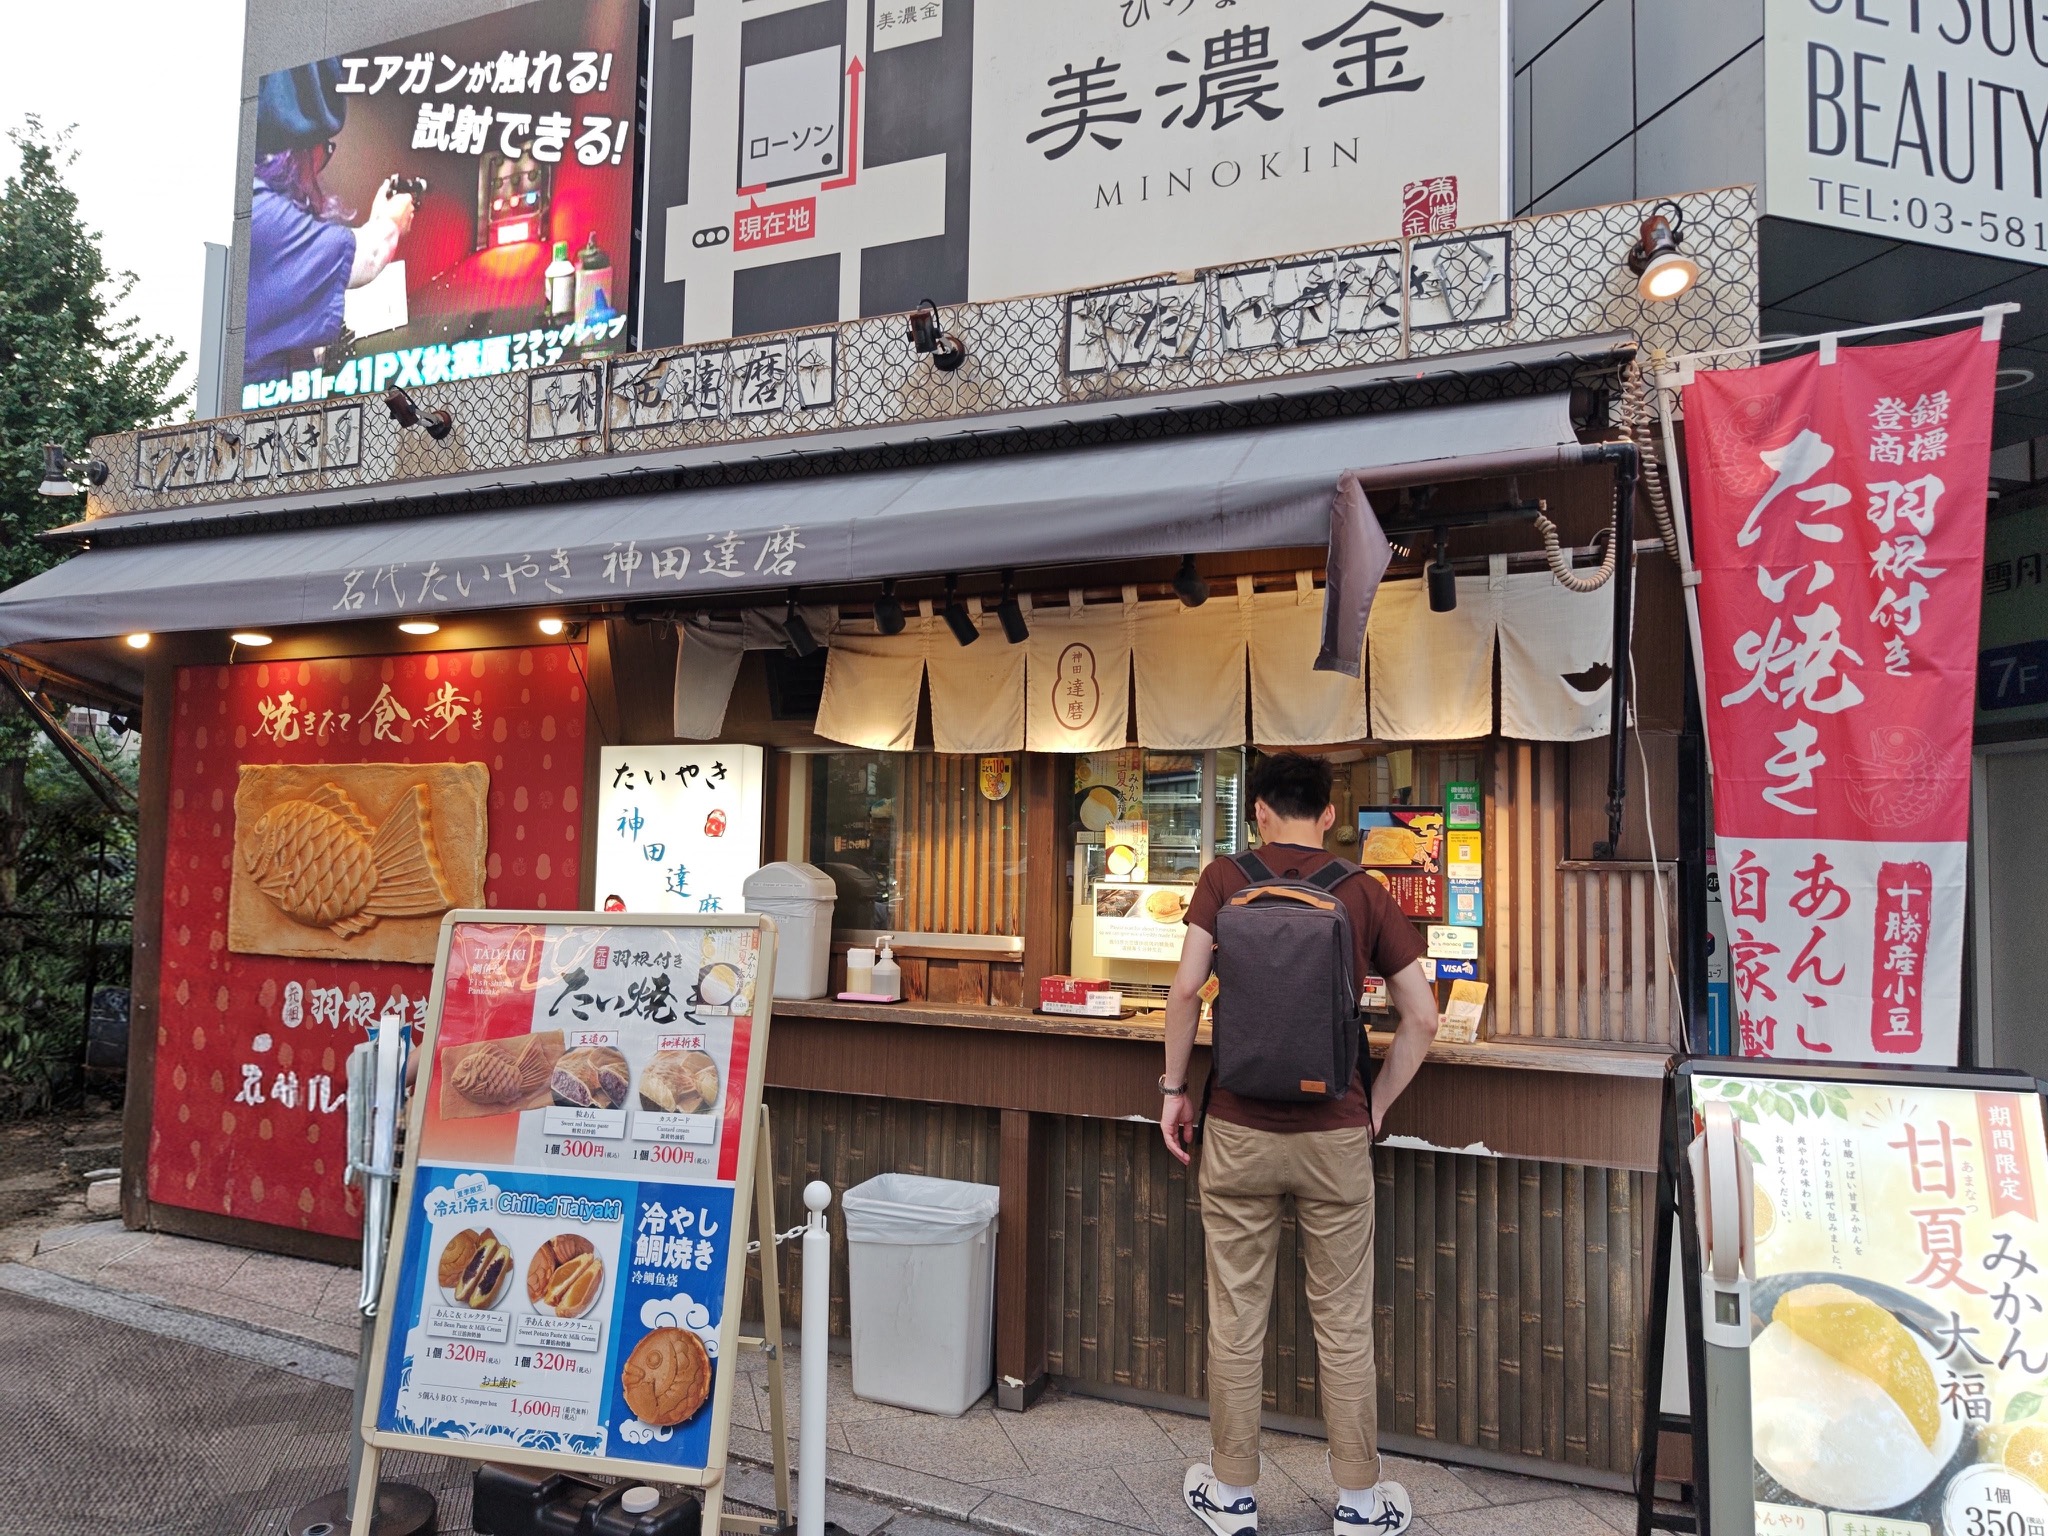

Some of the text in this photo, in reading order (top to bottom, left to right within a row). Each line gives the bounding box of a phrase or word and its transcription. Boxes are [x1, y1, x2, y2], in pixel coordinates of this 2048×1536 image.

[876, 2, 941, 32] 美濃金
[335, 51, 613, 95] エアガンが触れる!
[1026, 1, 1445, 161] 美濃金
[411, 103, 629, 165] 試射できる!
[1808, 41, 2048, 199] BEAUTY
[751, 125, 834, 159] ローソン
[1094, 137, 1361, 210] MINOKIN
[739, 207, 810, 242] 現在地
[513, 347, 564, 372] ストア
[1868, 389, 1951, 431] 登録
[1868, 427, 1950, 466] 商標
[602, 524, 806, 588] 神田達磨
[1985, 552, 2048, 595] 雪月
[332, 547, 572, 611] 名代たいやき
[1865, 473, 1947, 677] 羽根付き
[1720, 428, 1865, 815] たい焼き
[1065, 650, 1086, 721] 神田達磨
[1989, 656, 2038, 698] 7F
[252, 690, 351, 742] 焼きたて
[358, 681, 483, 743] 食べ歩き
[612, 760, 728, 790] たいやき
[1128, 773, 1139, 803] みかん
[1425, 876, 1437, 916] たい焼き
[474, 947, 526, 961] TAIYAKI
[596, 948, 607, 968] 元祖
[613, 948, 682, 970] 羽根付き
[746, 952, 757, 979] みかん
[1441, 964, 1463, 974] VISA
[1787, 852, 1852, 1053] あんこ
[1882, 880, 1923, 1037] 十勝産小豆
[285, 987, 302, 1022] 元祖
[579, 1034, 608, 1045] 王道の
[576, 1110, 596, 1119] 粒あん
[659, 1116, 691, 1124] カスタード
[544, 1144, 560, 1155] 1個
[561, 1139, 604, 1158] 300円
[633, 1150, 649, 1161] 1個
[650, 1145, 694, 1164] 300円
[1987, 1105, 2023, 1202] 期間限定
[457, 1185, 484, 1198] 夏季限定
[1775, 1135, 1792, 1224] お楽しみください。
[1797, 1135, 1813, 1221] 爽やかな味わいを
[1961, 1160, 1979, 1213] あまなつ
[499, 1193, 621, 1222] Chilled Taiyaki
[638, 1202, 718, 1237] 冷やし
[1820, 1137, 1843, 1270] ふんわりお餅で包みました。
[1887, 1120, 1988, 1296] 甘夏
[634, 1233, 714, 1271] 鯛焼き
[1983, 1234, 2048, 1375] みかん
[456, 1322, 468, 1330] Paste
[533, 1330, 549, 1338] Potato
[550, 1331, 562, 1339] Paste
[426, 1347, 442, 1359] 1個
[445, 1343, 486, 1363] 320円
[514, 1356, 531, 1368] 1個
[533, 1352, 576, 1372] 320円
[1936, 1311, 1995, 1424] 大福
[481, 1375, 517, 1389] お土産に
[465, 1398, 479, 1406] pieces
[510, 1397, 561, 1418] 1,600円
[1985, 1486, 2012, 1505] 1個
